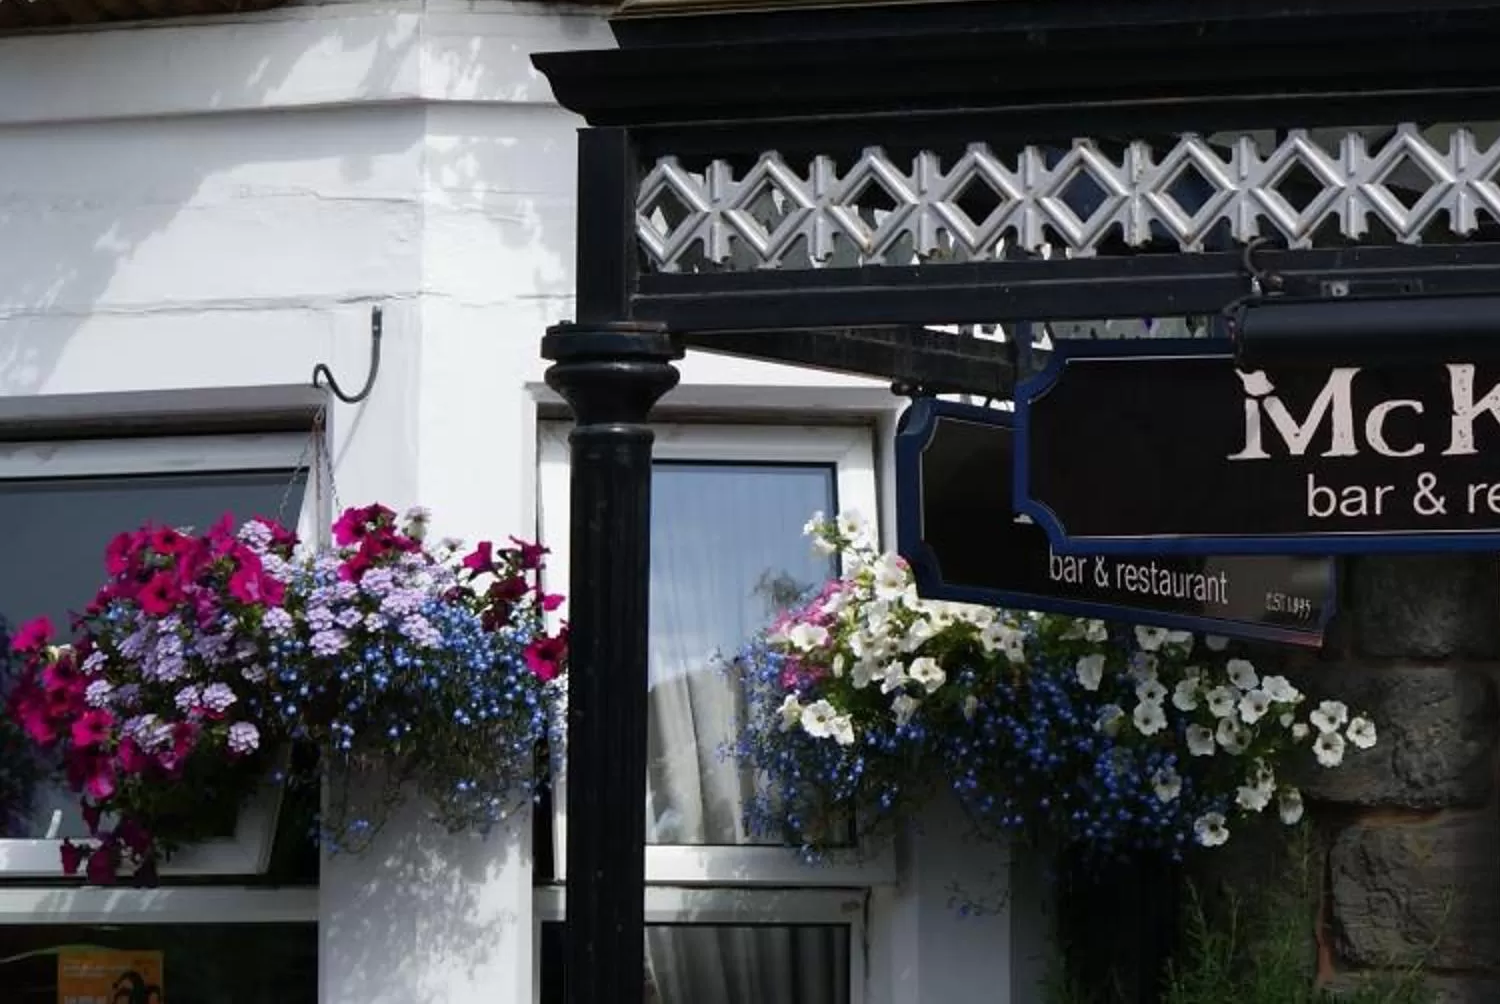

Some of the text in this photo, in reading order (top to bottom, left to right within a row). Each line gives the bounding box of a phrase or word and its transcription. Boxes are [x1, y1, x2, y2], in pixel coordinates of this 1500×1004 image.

[1307, 473, 1394, 518] bar
[1412, 471, 1447, 516] &
[1050, 545, 1229, 604] bar & restaurant
